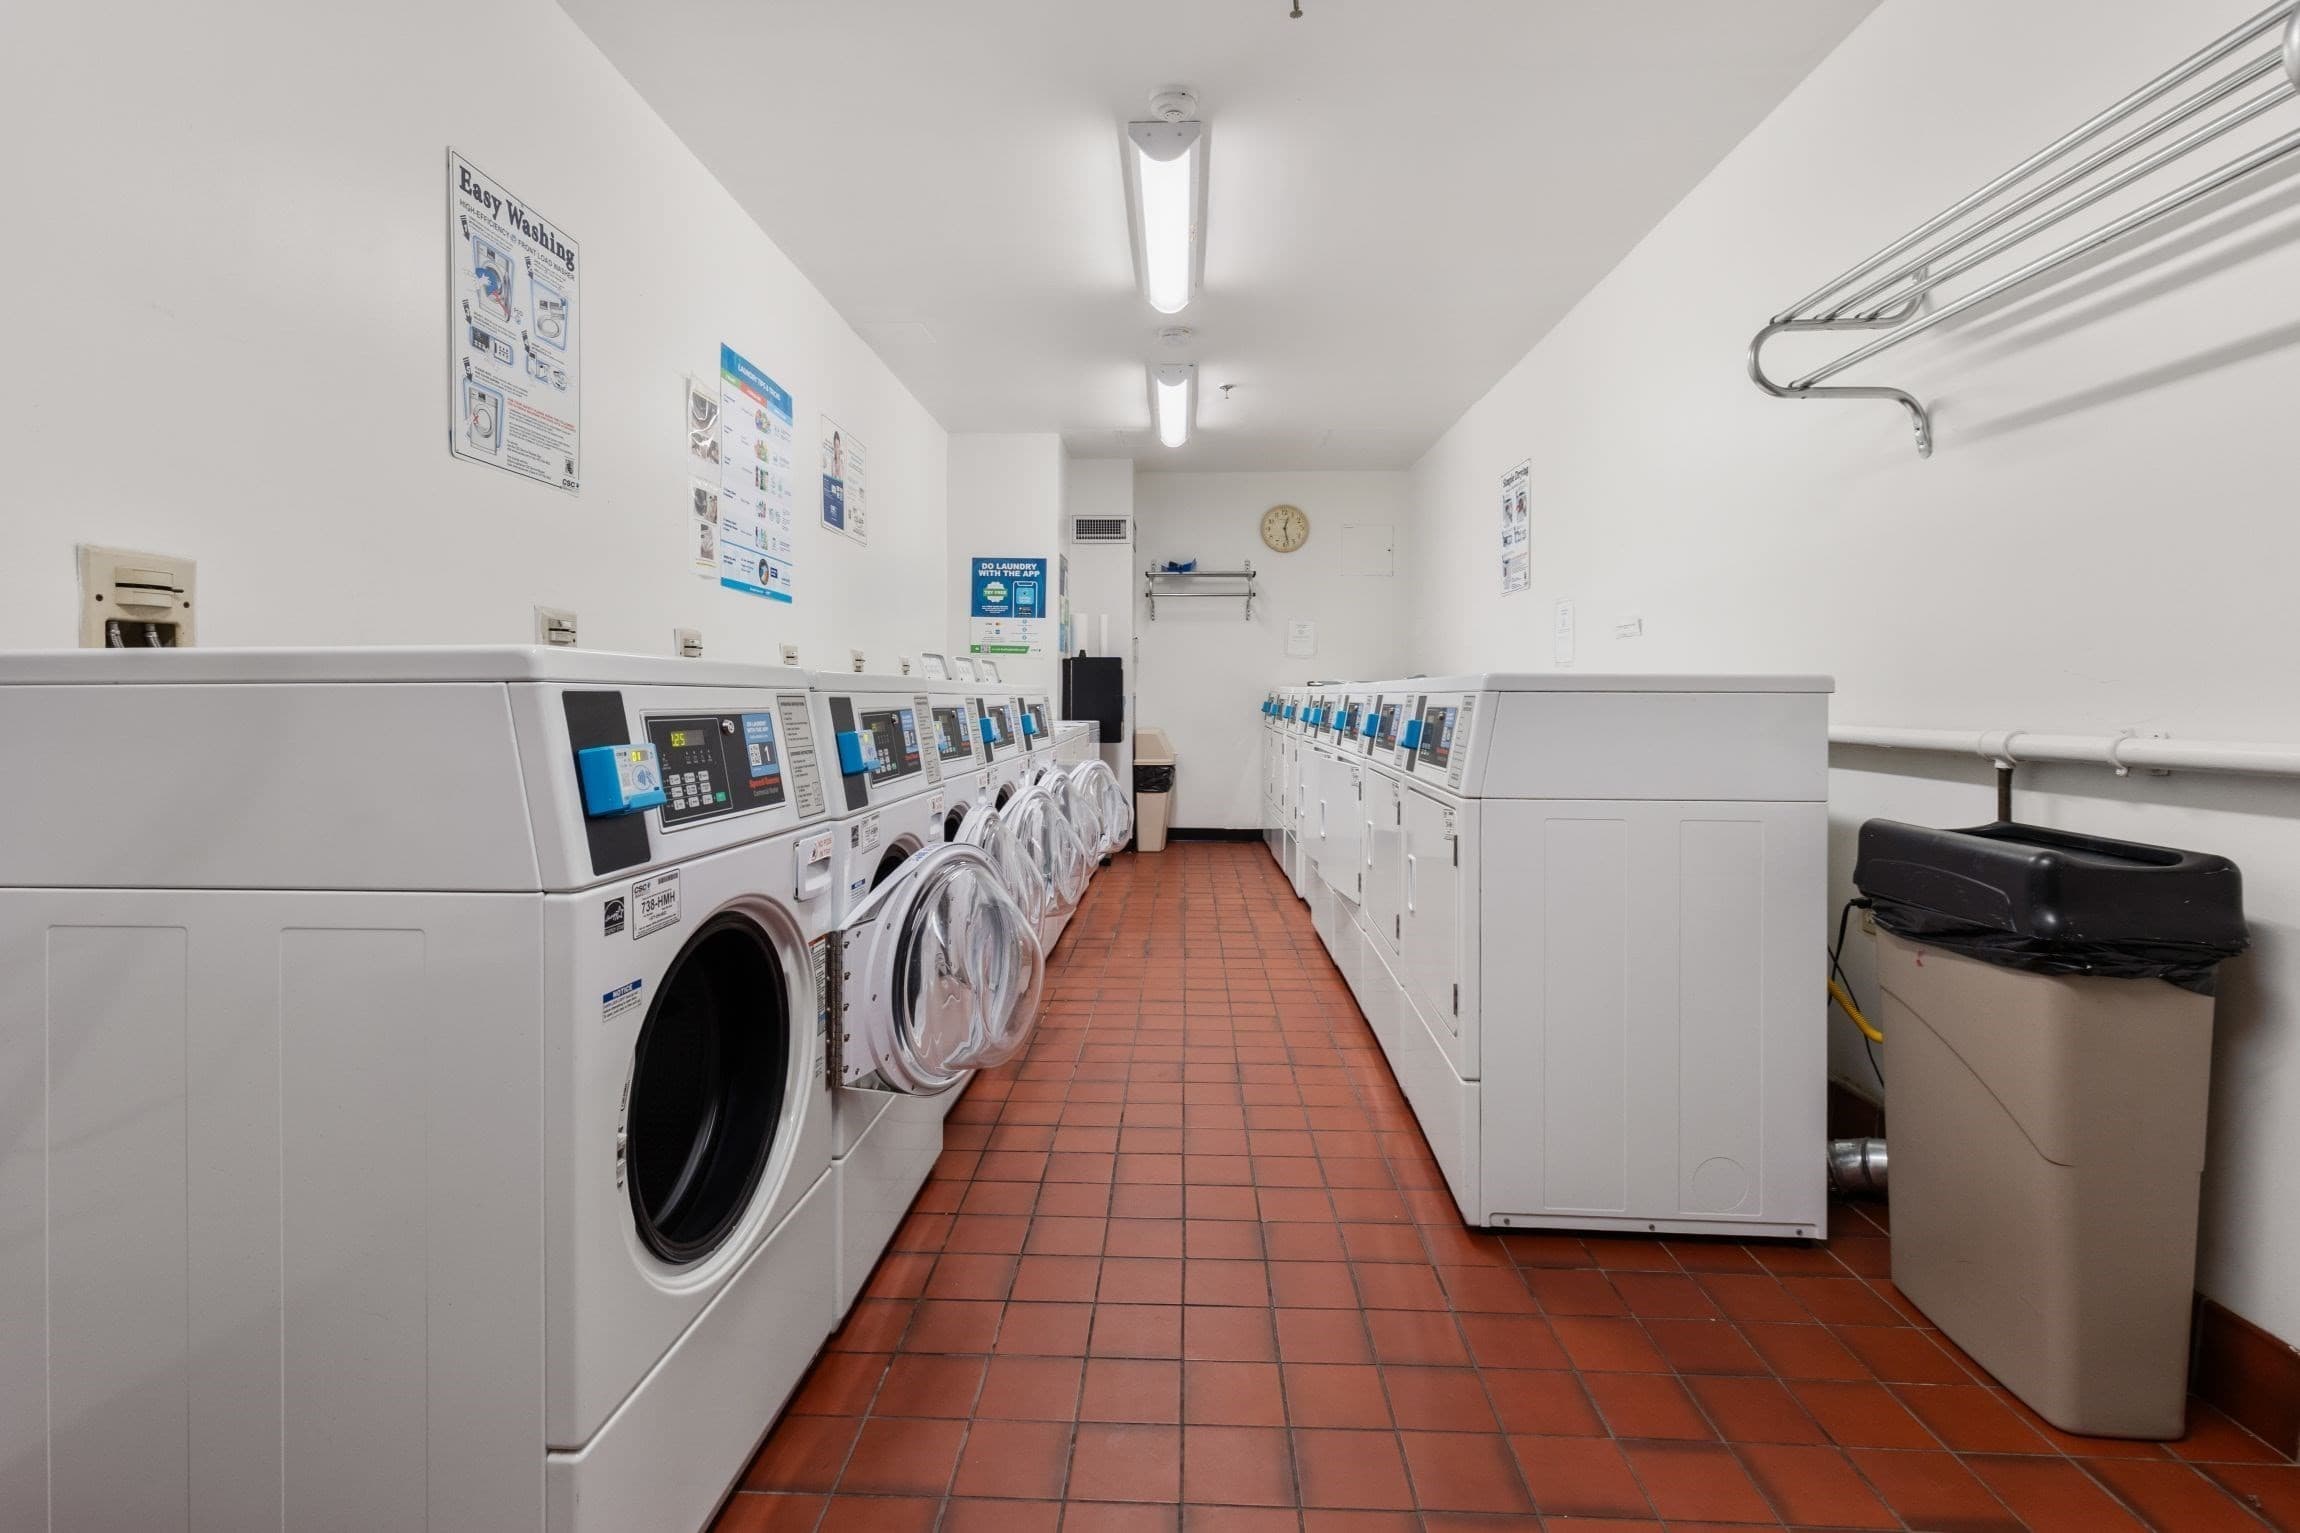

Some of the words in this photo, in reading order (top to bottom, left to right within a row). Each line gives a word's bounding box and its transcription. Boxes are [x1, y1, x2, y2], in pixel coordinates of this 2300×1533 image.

[459, 165, 502, 220] Easy
[506, 199, 575, 272] Washing
[562, 479, 576, 488] CSC
[981, 562, 994, 570] DO
[996, 562, 1038, 570] LAUNDRY
[1022, 570, 1041, 578] APP
[764, 745, 771, 762] 1
[634, 884, 647, 894] CSC
[641, 891, 676, 914] 738-HMH
[612, 983, 633, 999] NOTICE
